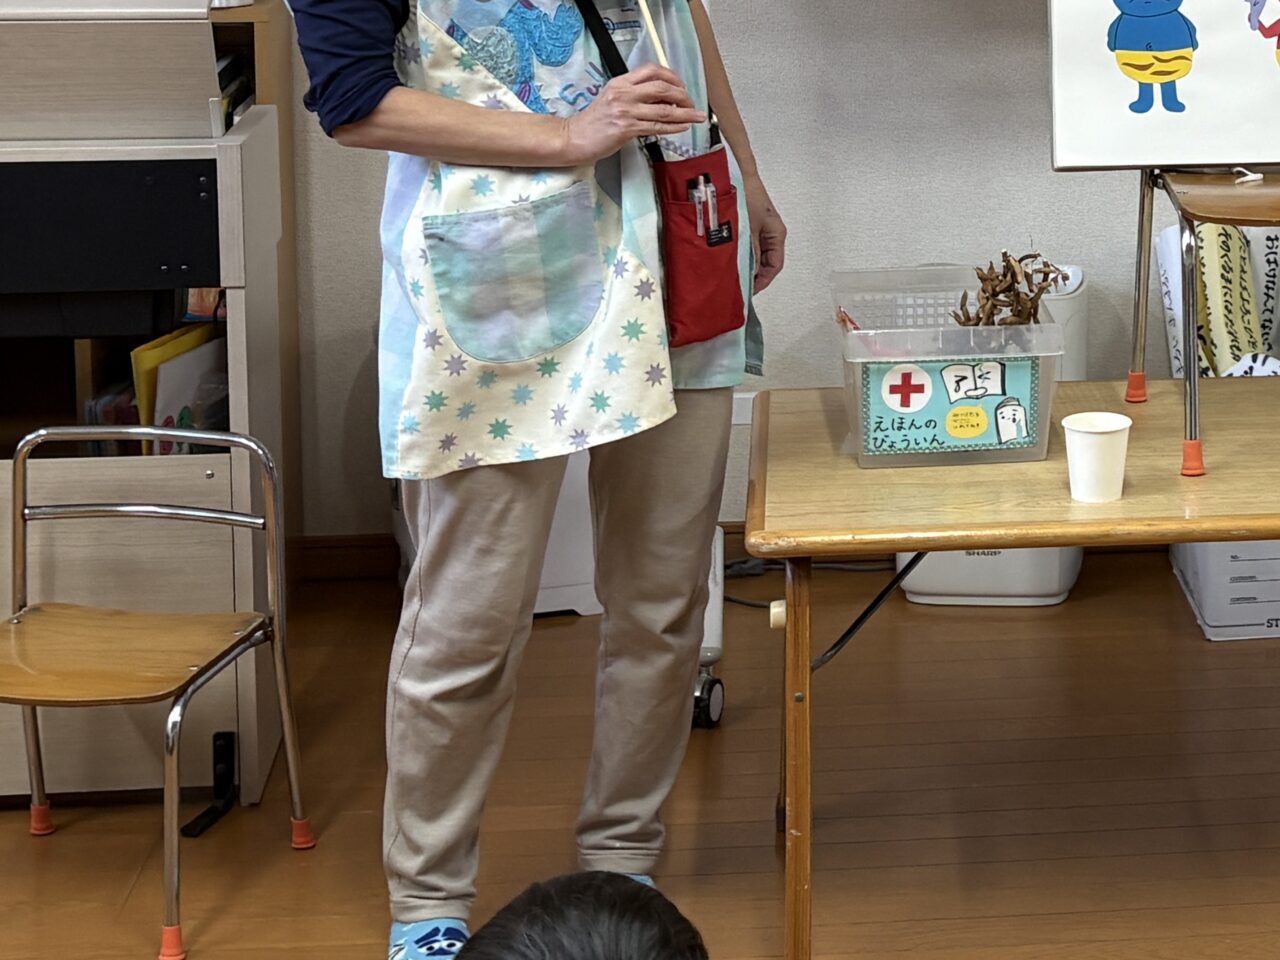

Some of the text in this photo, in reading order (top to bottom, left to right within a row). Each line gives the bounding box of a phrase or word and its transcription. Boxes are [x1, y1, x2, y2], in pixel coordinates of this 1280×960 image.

[873, 416, 938, 432] えほんの
[872, 434, 946, 450] びょういん
